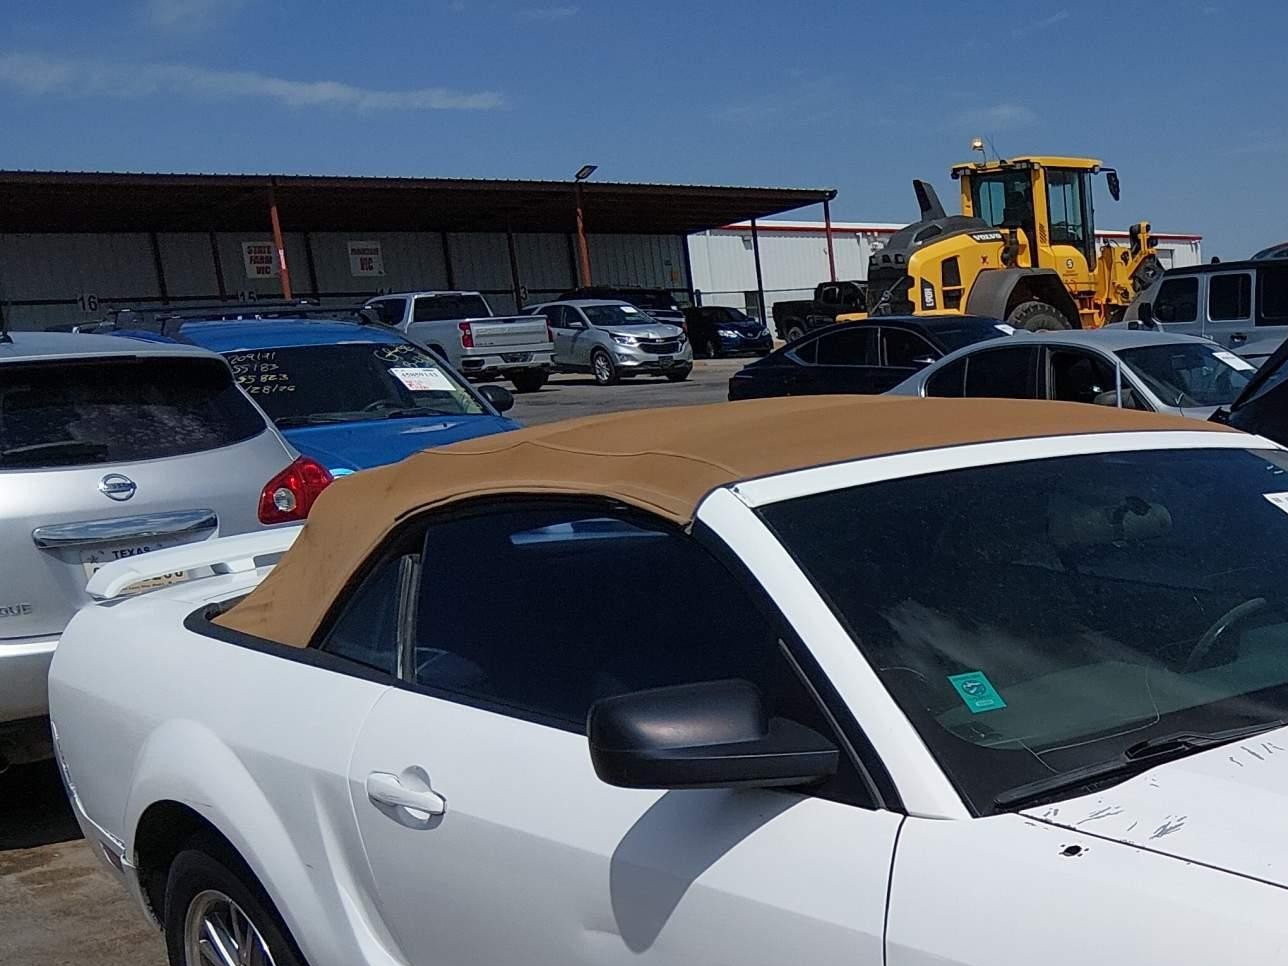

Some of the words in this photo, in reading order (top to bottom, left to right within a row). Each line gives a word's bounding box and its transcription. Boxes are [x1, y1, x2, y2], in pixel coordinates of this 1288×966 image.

[972, 232, 1002, 241] VOLVO
[247, 245, 272, 254] STATE
[249, 255, 273, 265] FARM
[360, 257, 374, 271] VIC
[256, 266, 271, 275] VIC
[78, 294, 98, 312] 16
[111, 546, 152, 560] TEXAS
